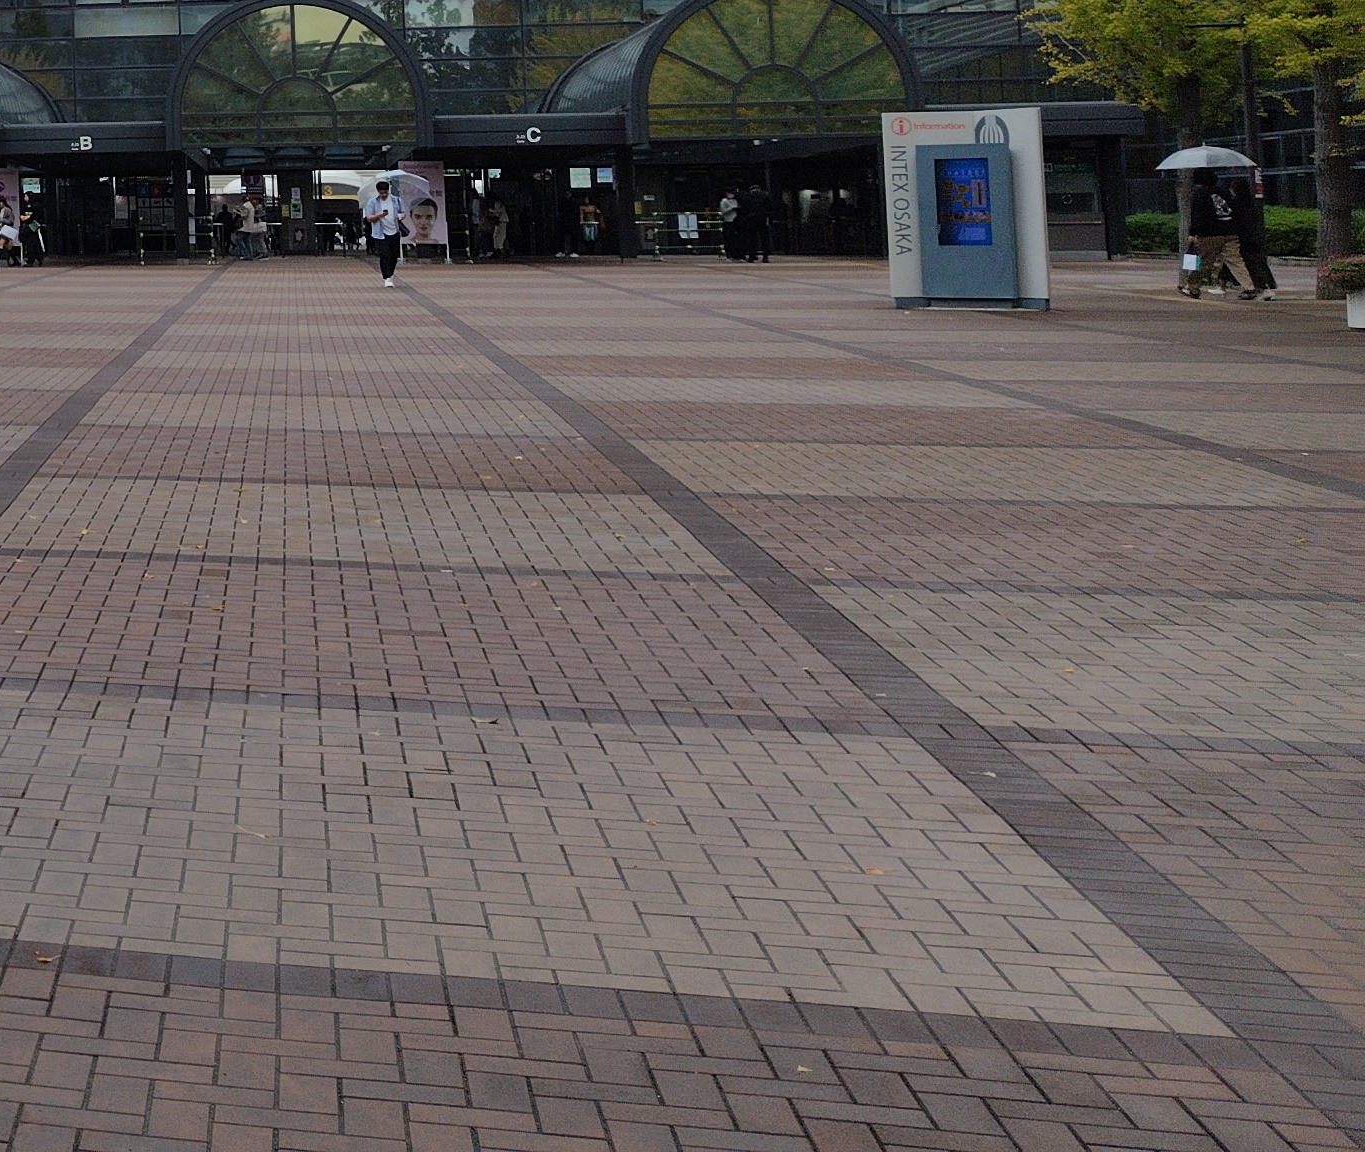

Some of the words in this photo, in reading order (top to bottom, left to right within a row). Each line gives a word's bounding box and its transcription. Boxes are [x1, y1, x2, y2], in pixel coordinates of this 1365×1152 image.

[79, 136, 93, 151] B
[526, 127, 542, 143] C
[890, 145, 910, 193] INTEX
[893, 197, 913, 256] OSAKA
